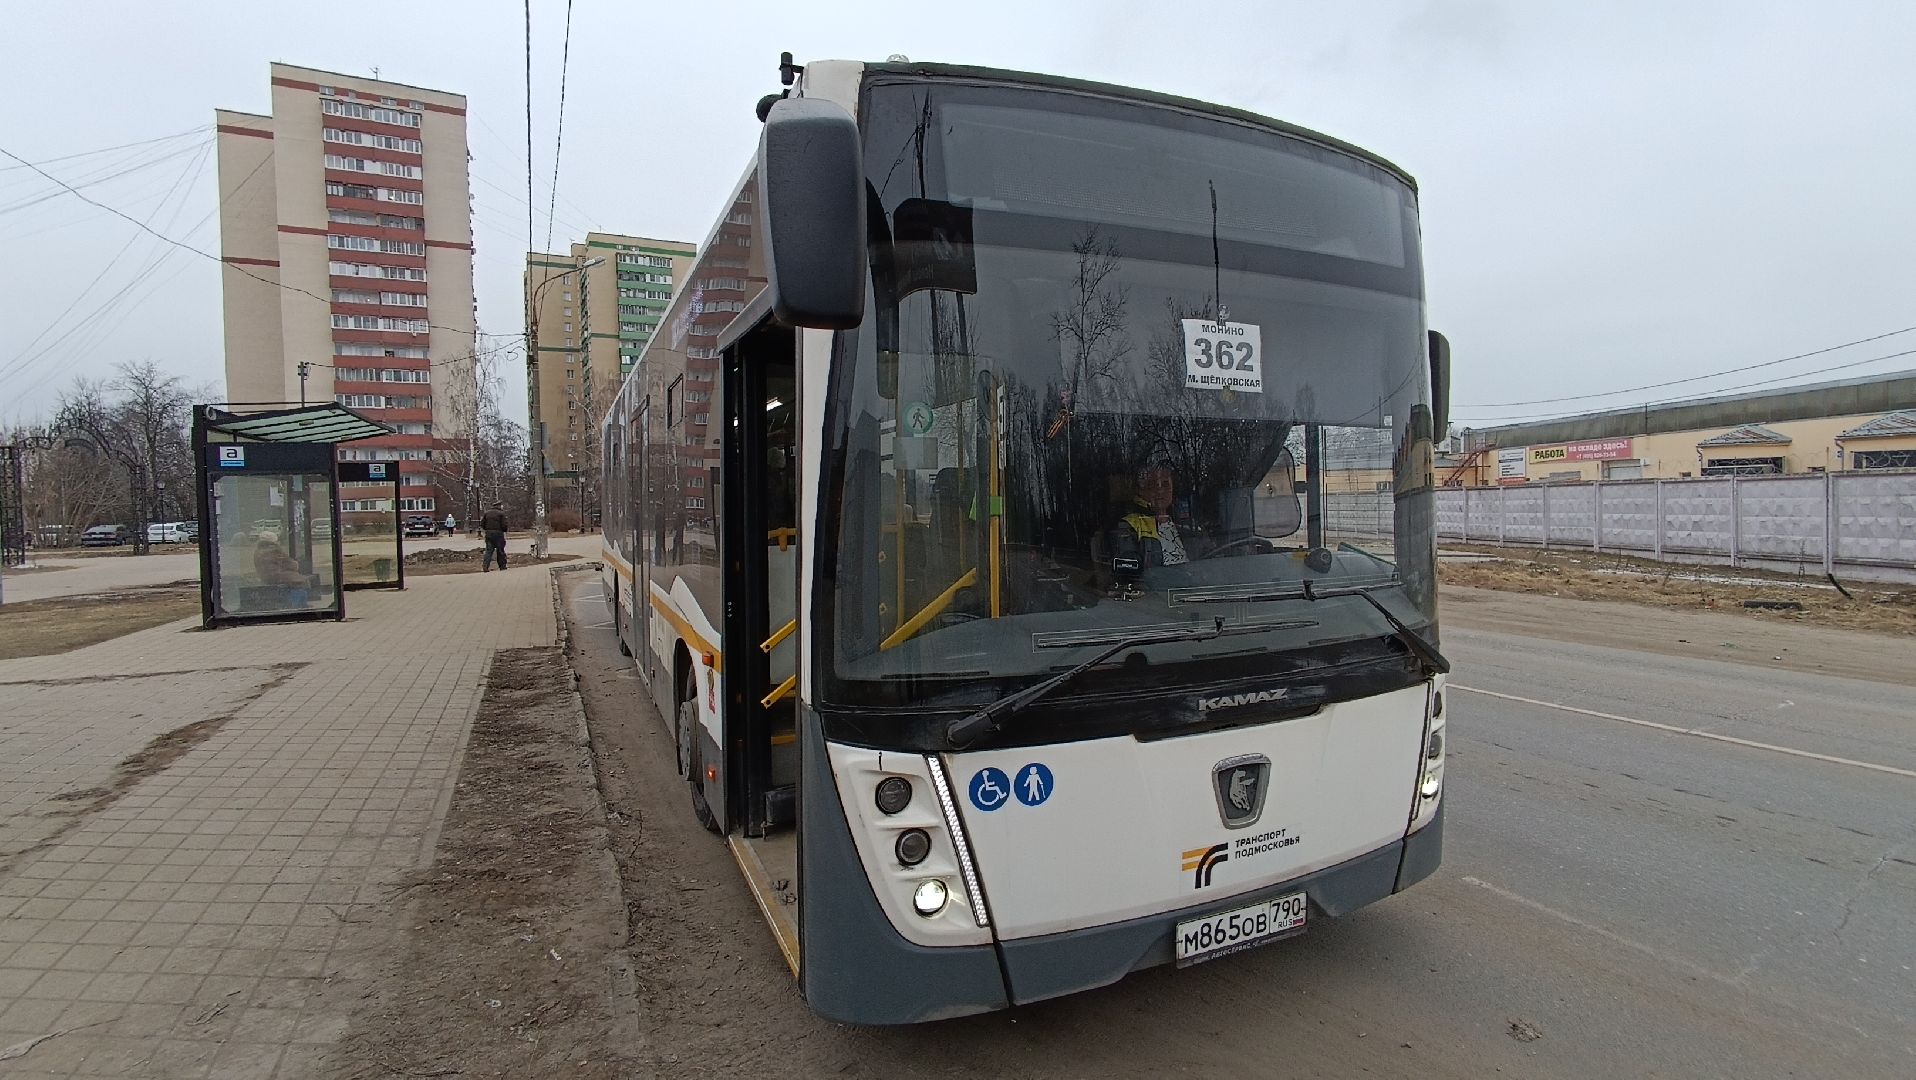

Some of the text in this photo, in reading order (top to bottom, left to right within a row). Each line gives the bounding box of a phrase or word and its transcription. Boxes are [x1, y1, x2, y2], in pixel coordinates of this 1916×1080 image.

[1202, 324, 1244, 336] МОНИНО
[1194, 338, 1254, 372] 362
[1187, 374, 1199, 383] М.
[1535, 449, 1564, 459] РАБОТА
[1198, 688, 1288, 711] KAMAZ
[1235, 828, 1286, 848] ТРАНСПОРТ
[1235, 836, 1300, 859] ПОДМОСКОВЬЯ
[1184, 897, 1301, 955] М865ОВ 790
[1277, 918, 1293, 929] RUS
